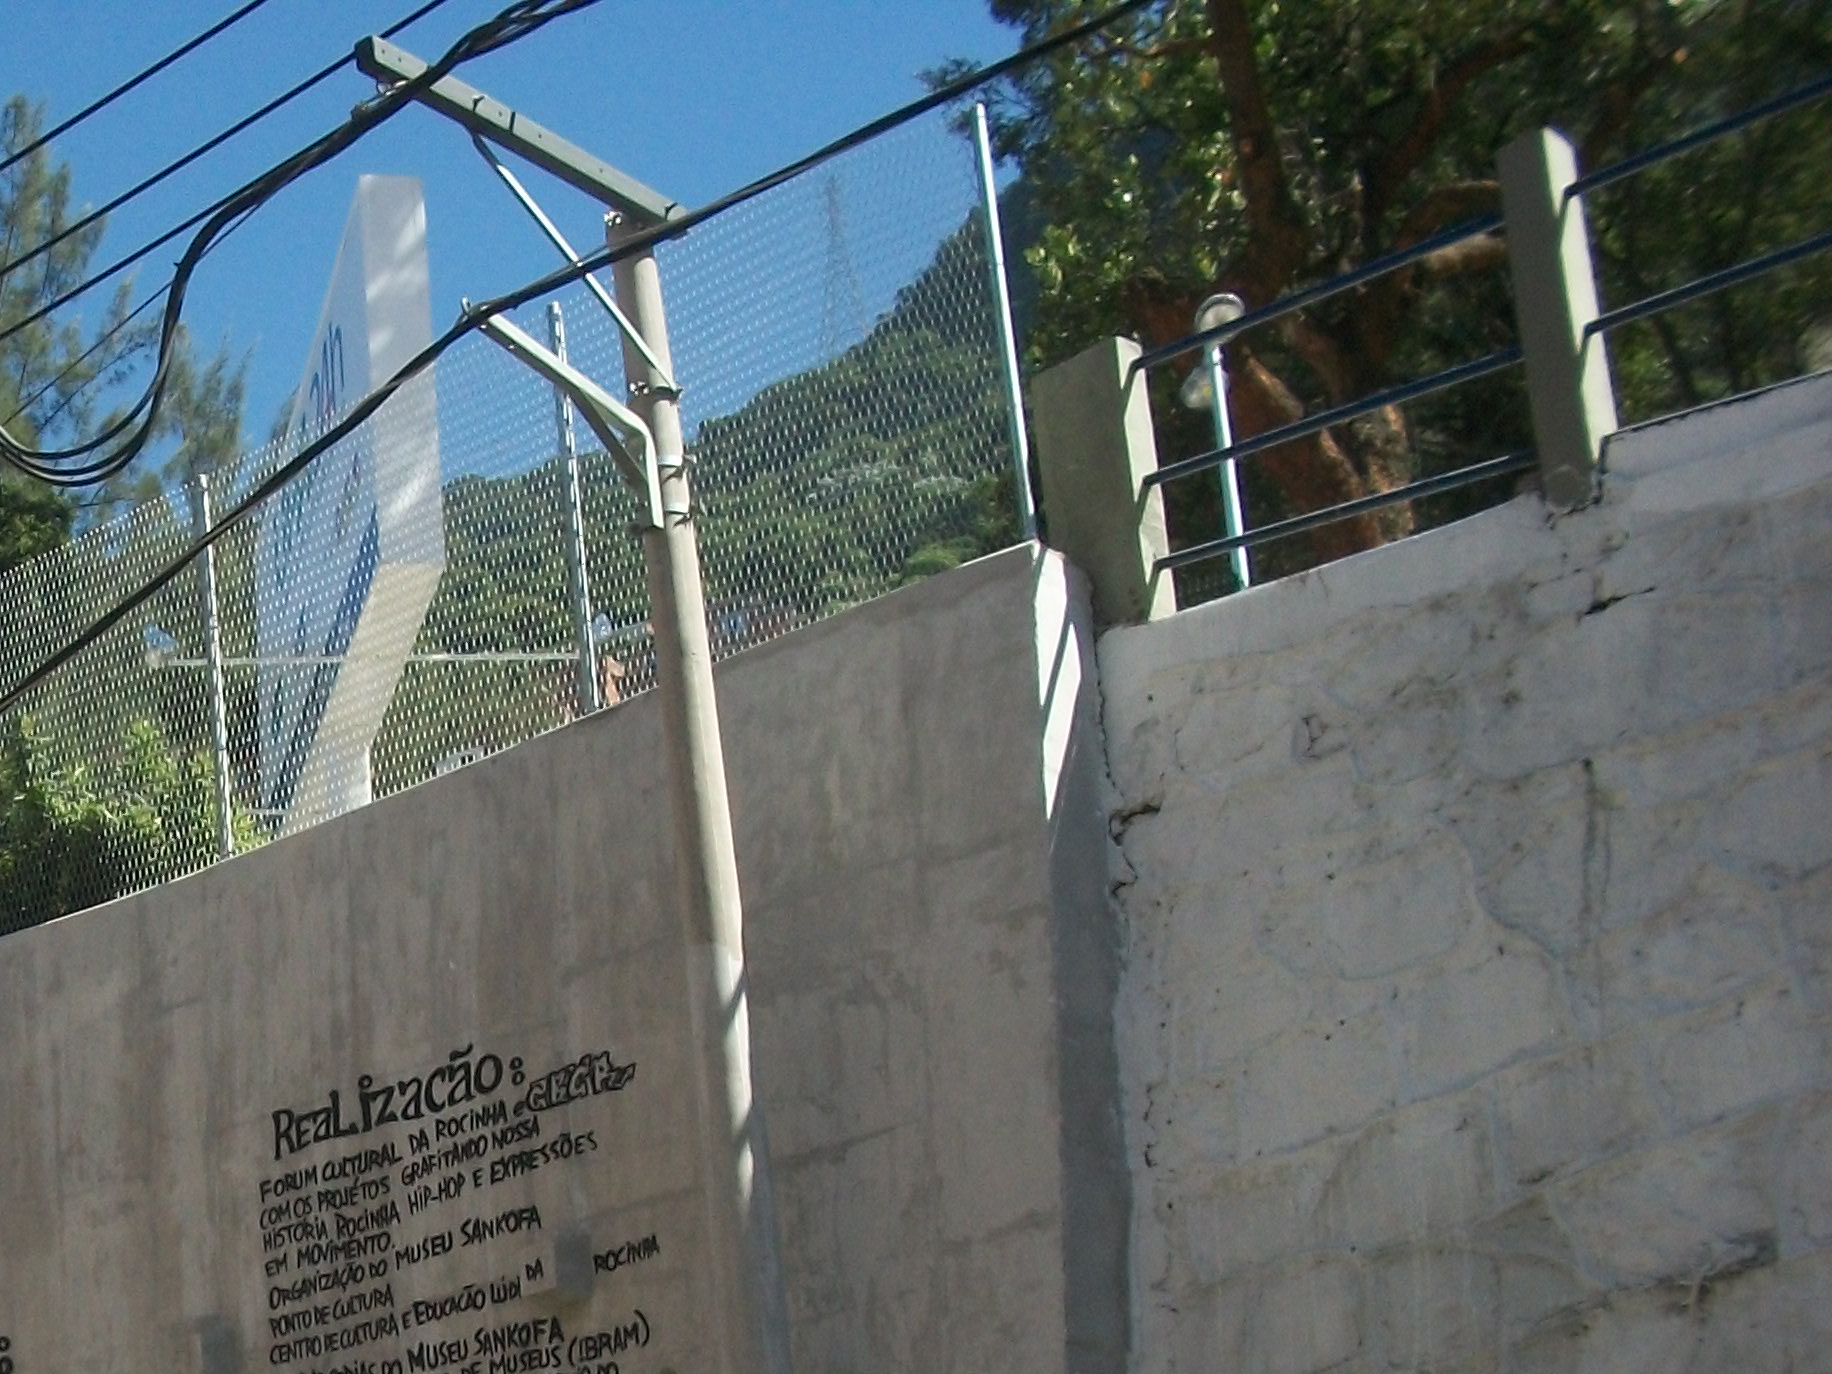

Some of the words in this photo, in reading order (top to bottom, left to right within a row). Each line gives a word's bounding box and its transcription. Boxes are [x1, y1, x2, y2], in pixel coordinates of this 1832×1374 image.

[259, 1165, 318, 1203] FORUM
[323, 1141, 403, 1182] CULTURAL
[408, 1128, 430, 1156] DA
[434, 1100, 508, 1142] ROCINHA
[260, 1199, 291, 1230] COM
[401, 1134, 488, 1187] GRAFITANDO
[492, 1114, 540, 1150] NOSSA
[335, 1199, 401, 1240] ROCINHA
[408, 1171, 466, 1217] HIP-HOP
[490, 1129, 598, 1186] EXPRESSÕES
[265, 1252, 288, 1277] EM
[269, 1261, 365, 1310] ORGANIZAÇÃO
[395, 1230, 454, 1271] MUSEU
[461, 1204, 542, 1247] SANKOFA
[269, 1334, 322, 1365] CENTRO
[340, 1313, 400, 1350] CULTURA
[525, 1257, 544, 1281] DA
[593, 1233, 660, 1275] ROCINHA
[269, 1309, 312, 1339] PONTO
[332, 1283, 395, 1320] CULTURA
[408, 1339, 468, 1374] MUSEU
[473, 1314, 565, 1358] SANKOFA
[568, 1308, 650, 1367] (IBRAM)
